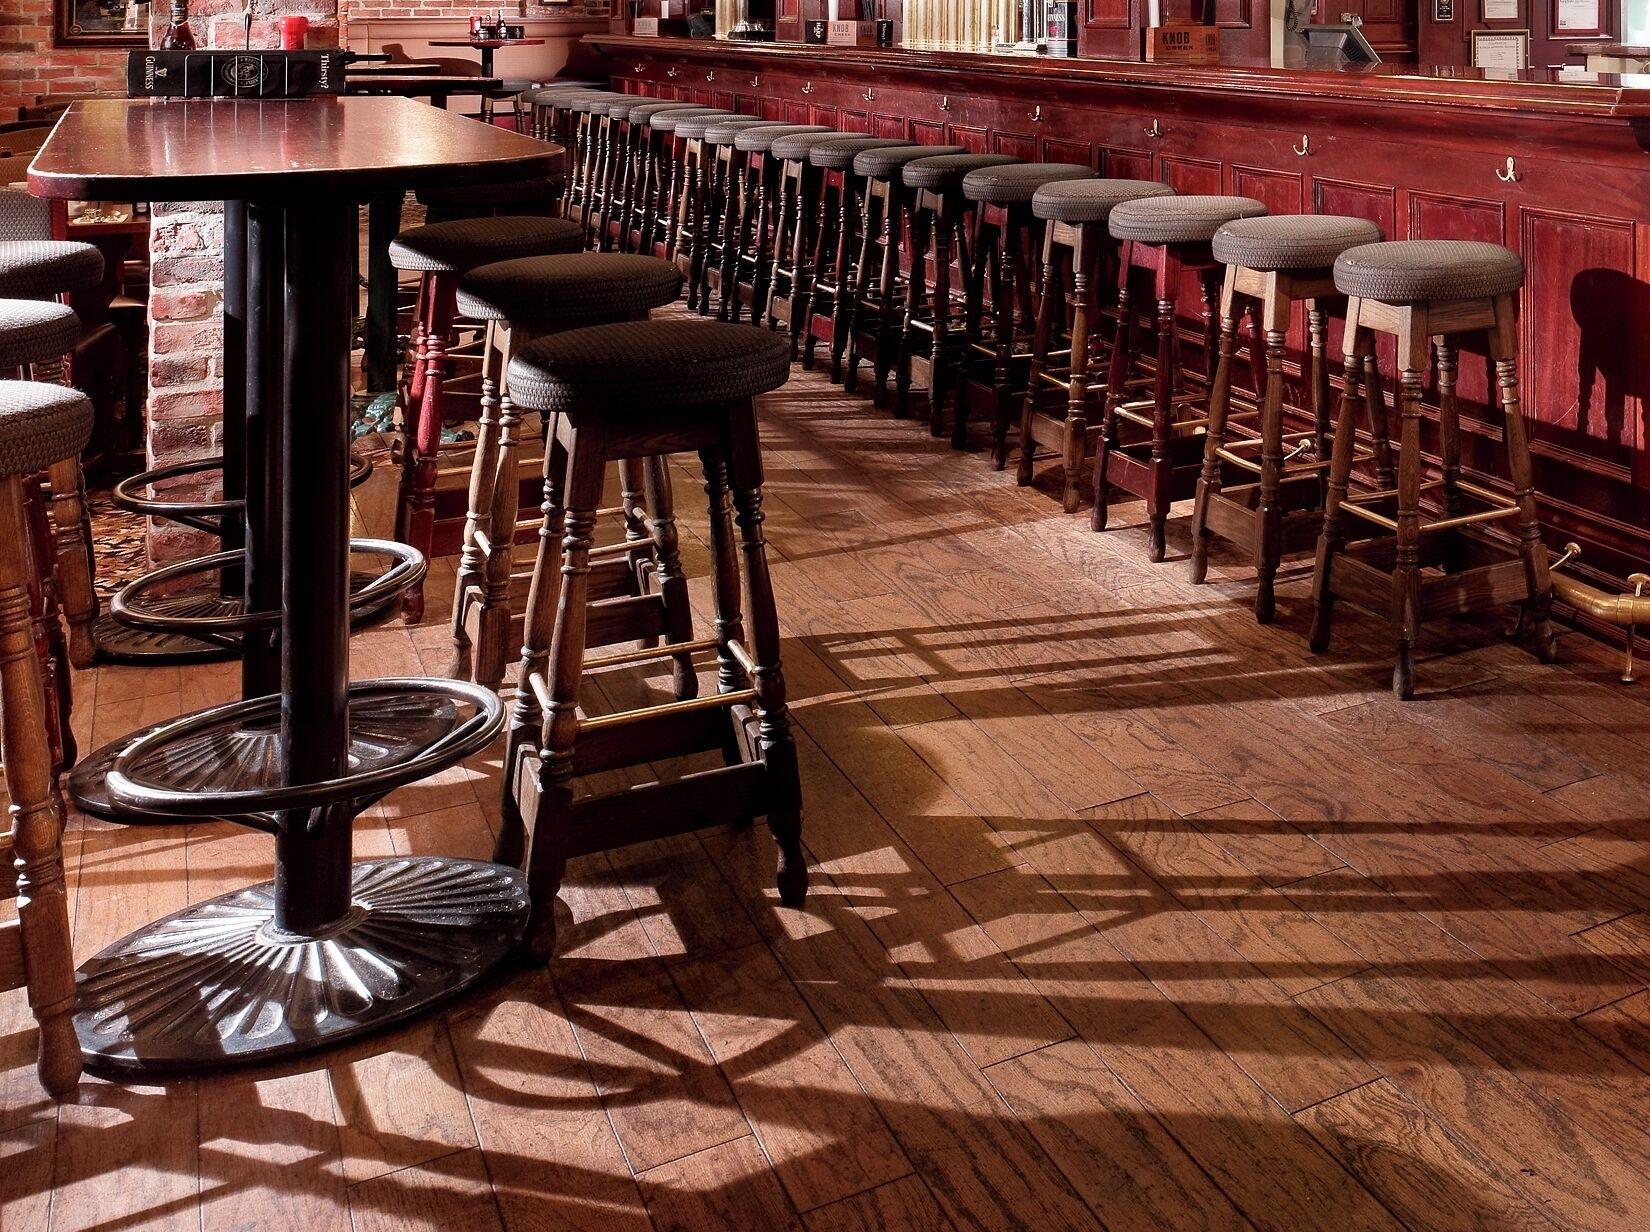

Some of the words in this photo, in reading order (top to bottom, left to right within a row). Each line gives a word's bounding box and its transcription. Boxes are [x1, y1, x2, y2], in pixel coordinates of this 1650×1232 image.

[832, 23, 849, 33] KNOB
[1162, 31, 1190, 45] KNOB
[145, 55, 155, 90] GUINNESS
[318, 53, 330, 89] Thirsty?
